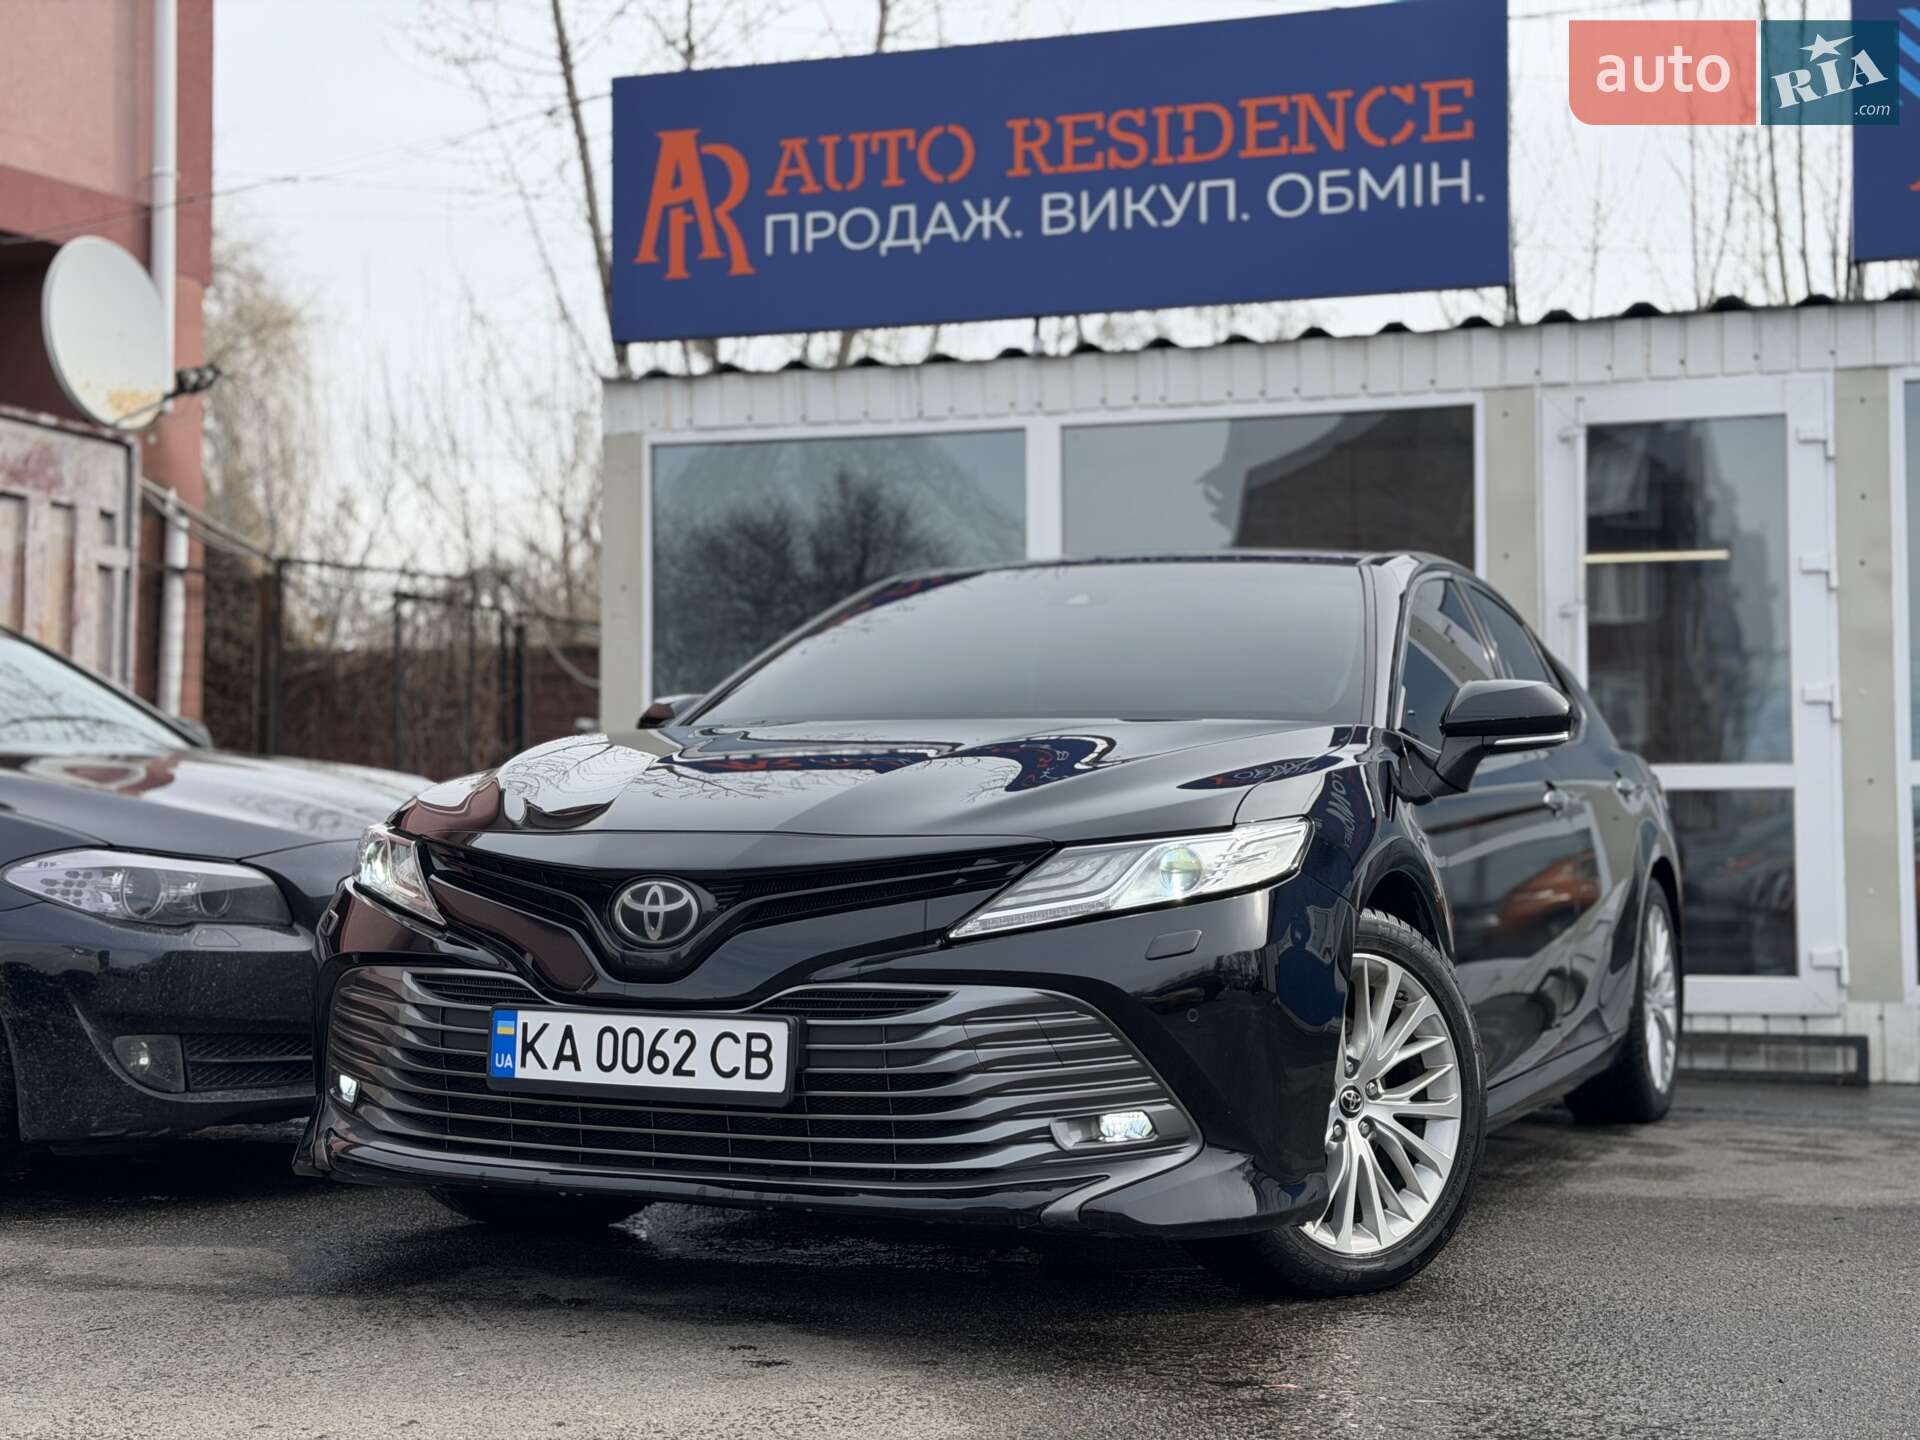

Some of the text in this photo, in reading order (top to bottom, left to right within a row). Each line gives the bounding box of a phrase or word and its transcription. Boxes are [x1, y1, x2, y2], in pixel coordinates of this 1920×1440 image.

[766, 78, 1474, 197] AUTO RESIDENCE
[765, 159, 1484, 256] ПРОДАЖ. ВИКУП. ОБМІН.
[495, 1053, 513, 1068] UA
[520, 1022, 774, 1081] KA 0062 CB
